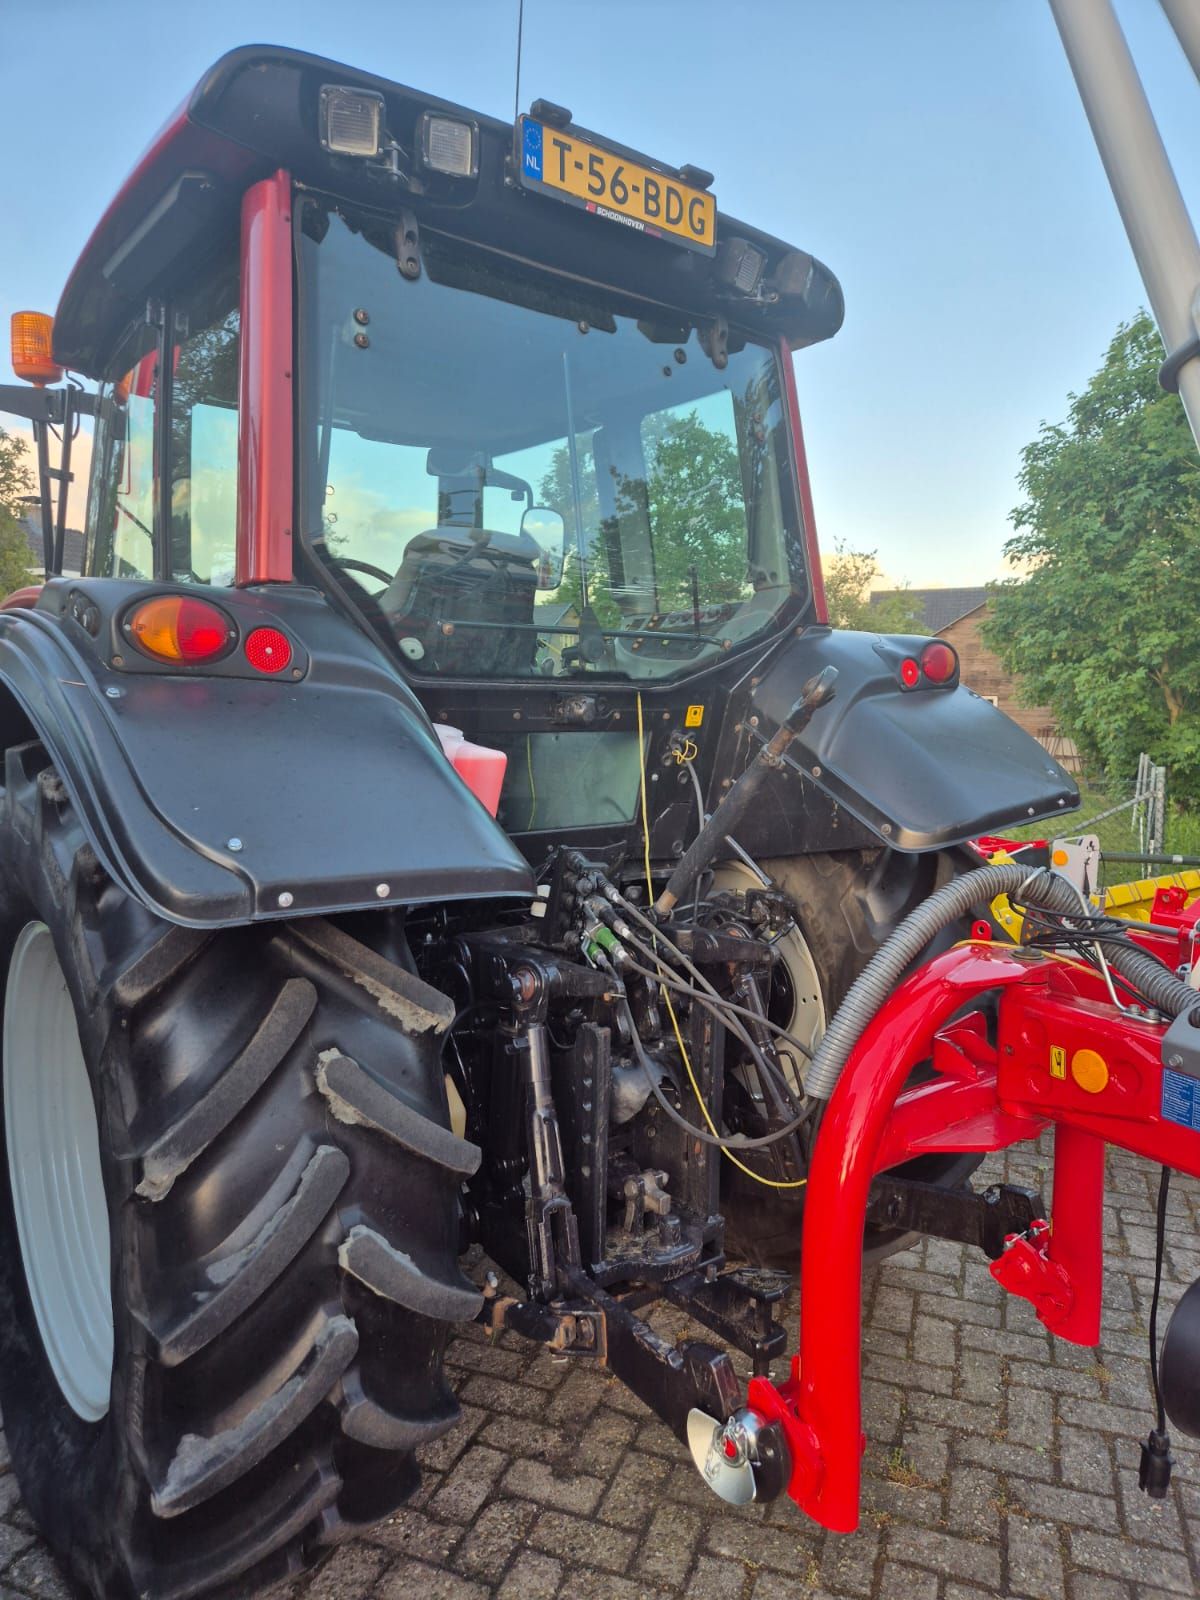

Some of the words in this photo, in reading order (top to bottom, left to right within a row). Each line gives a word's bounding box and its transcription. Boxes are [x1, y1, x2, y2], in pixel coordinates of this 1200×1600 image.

[526, 154, 541, 171] NL
[552, 137, 705, 236] T-56-BDG
[597, 206, 645, 232] SCHOONHOVEN
